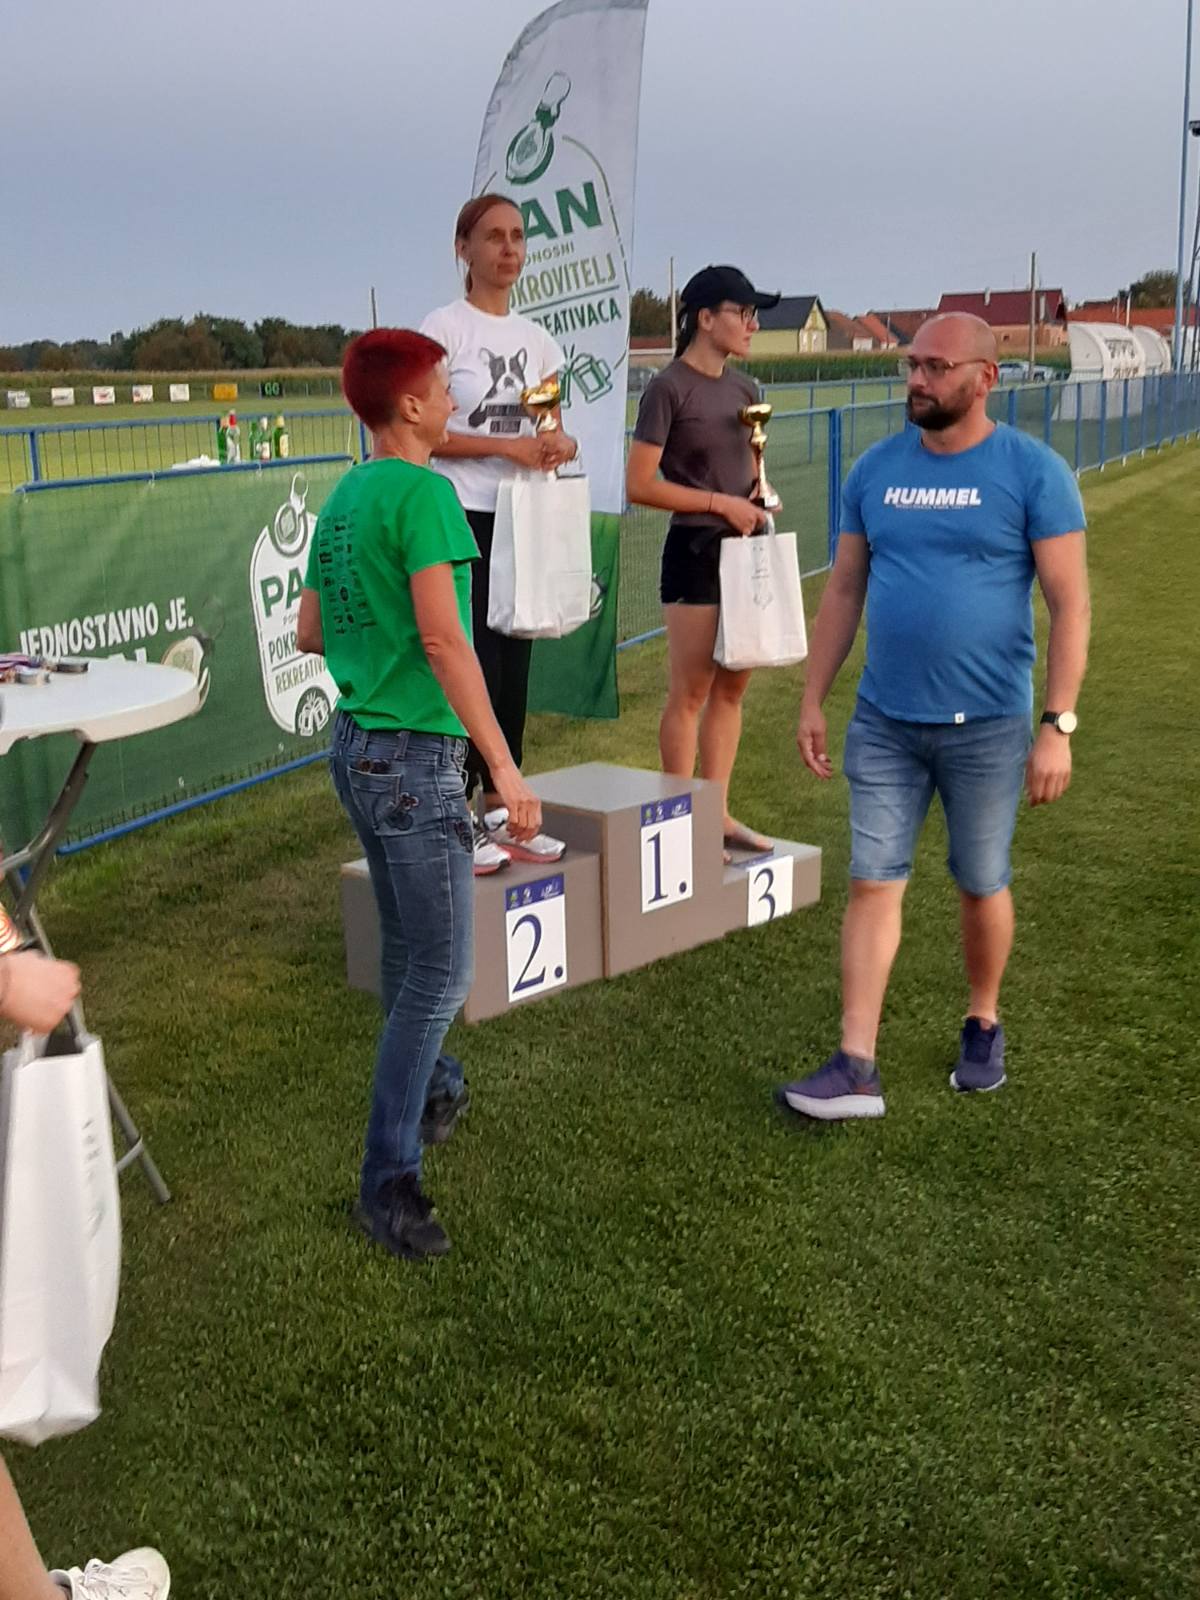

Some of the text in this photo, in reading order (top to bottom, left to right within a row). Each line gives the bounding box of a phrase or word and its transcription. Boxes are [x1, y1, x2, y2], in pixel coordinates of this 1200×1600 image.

[520, 181, 602, 240] AN
[510, 252, 616, 309] KROVITELJ
[525, 241, 574, 266] NOSNI
[531, 297, 622, 338] EATIVACA
[883, 487, 981, 505] HUMMEL
[260, 567, 303, 618] PA
[20, 597, 195, 662] JEDNOSTAVNO JE.
[647, 831, 688, 903] 1.
[753, 867, 776, 921] 3
[511, 913, 565, 994] 2.
